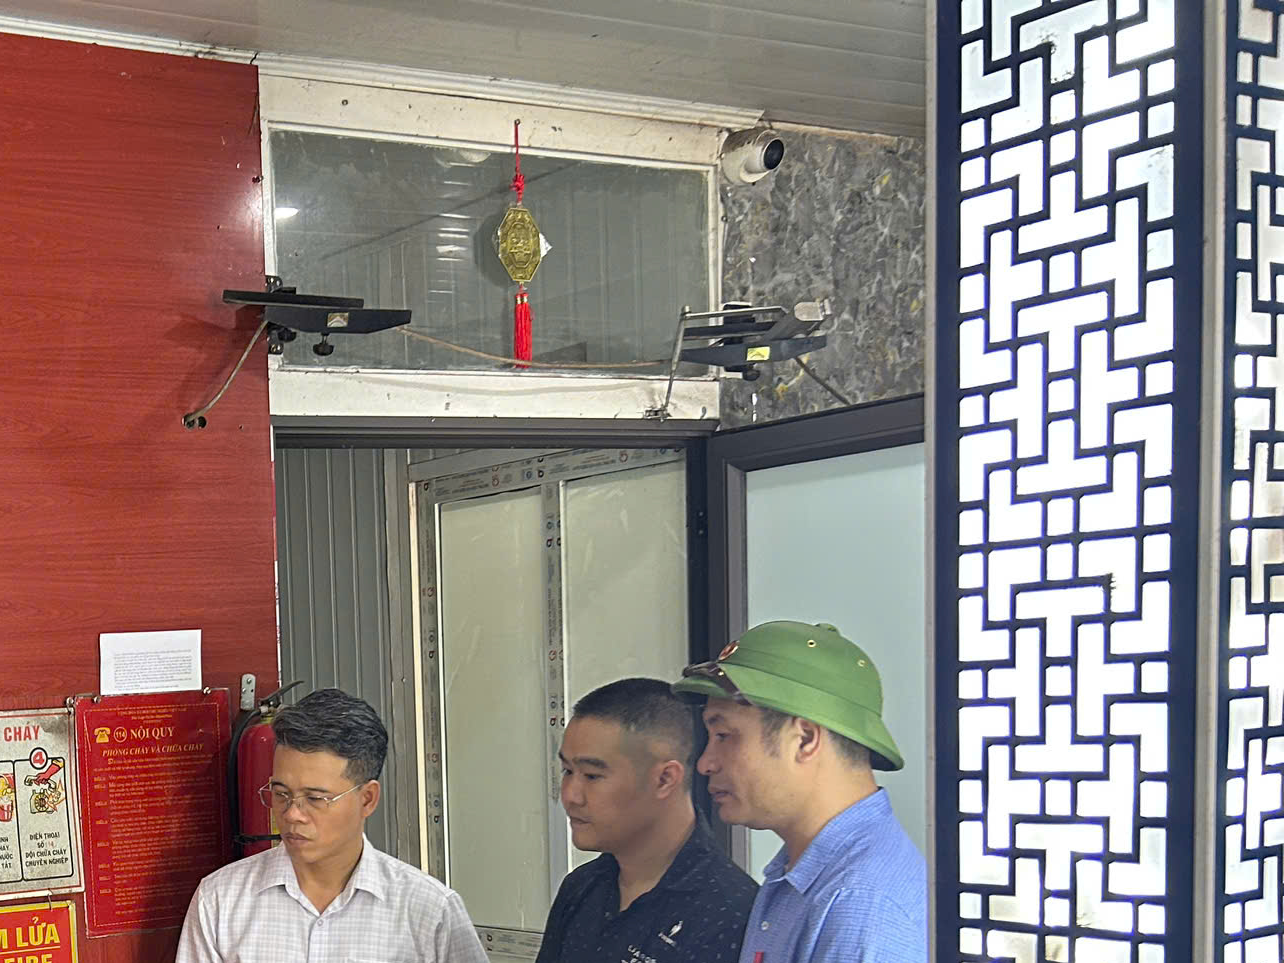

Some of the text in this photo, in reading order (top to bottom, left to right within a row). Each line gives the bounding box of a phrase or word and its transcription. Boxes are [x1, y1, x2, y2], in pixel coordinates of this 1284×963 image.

[3, 721, 42, 742] CHÁY
[130, 725, 175, 740] NỘI QUY
[32, 752, 44, 766] 4
[16, 916, 61, 947] LỬA
